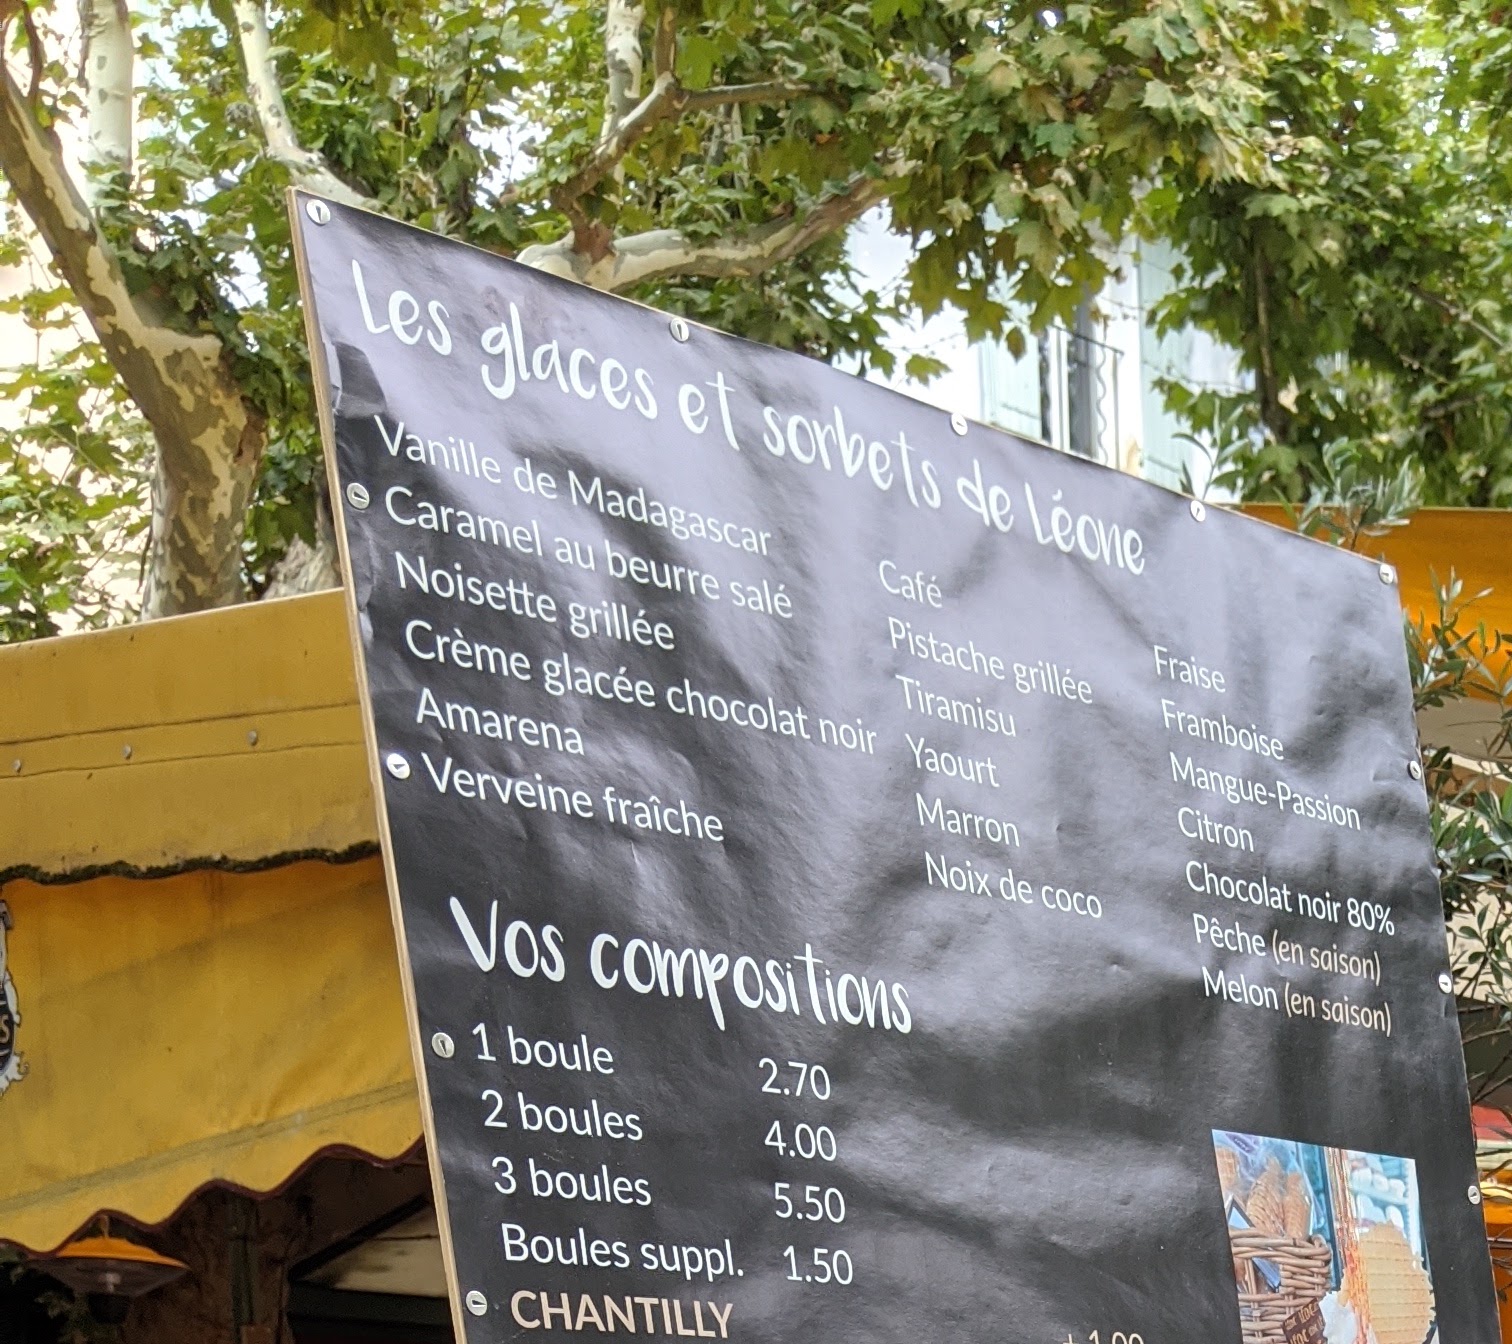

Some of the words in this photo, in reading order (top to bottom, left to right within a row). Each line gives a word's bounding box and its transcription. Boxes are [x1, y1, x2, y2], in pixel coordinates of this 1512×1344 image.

[351, 259, 453, 356] Les
[480, 301, 658, 420] glaces
[678, 371, 740, 451] et
[763, 406, 941, 509] sorbets
[956, 459, 1014, 533] de
[1024, 482, 1145, 575] Léone
[373, 413, 502, 484] Vanille
[513, 457, 558, 499] de
[567, 469, 772, 556] Madagascar
[384, 485, 543, 558] Caramel
[554, 537, 596, 572] au
[604, 538, 720, 600] beurre
[729, 579, 793, 619] salé
[879, 559, 943, 608] Café
[394, 551, 560, 624] Noisette
[568, 600, 676, 651] grillée
[404, 618, 532, 681] Crème
[541, 651, 657, 708] glacée
[665, 677, 811, 740] chocolat
[818, 718, 877, 755] noir
[888, 616, 1006, 680] Pistache
[1013, 660, 1093, 705] grillée
[1153, 644, 1226, 694] Fraise
[415, 686, 585, 756] Amarena
[894, 674, 1016, 737] Tiramisu
[1161, 698, 1285, 761] Framboise
[423, 751, 594, 818] Verveine
[601, 786, 725, 842] fraîche
[904, 733, 1000, 788] Yaourt
[1169, 751, 1361, 831] Mangue-Passion
[915, 792, 1020, 848] Marron
[1177, 806, 1255, 864] Citron
[924, 850, 993, 898] Noix
[999, 868, 1034, 905] de
[1041, 885, 1103, 919] coco
[1185, 860, 1294, 915] Chocolat
[1297, 890, 1342, 924] noir
[1346, 896, 1396, 937] 80%
[449, 895, 566, 983] Vos
[589, 932, 912, 1035] compositions
[1192, 912, 1267, 957] Pêche
[1271, 928, 1304, 966] (en
[1309, 942, 1381, 987] saison)
[1201, 965, 1280, 1011] Melon
[1284, 981, 1316, 1019] (en
[1321, 994, 1392, 1038] saison)
[471, 1022, 497, 1062] 1
[506, 1024, 615, 1075] boule
[758, 1057, 831, 1101] 2.70
[481, 1088, 509, 1129] 2
[516, 1090, 644, 1141] boules
[764, 1119, 838, 1162] 4.00
[491, 1155, 517, 1195] 3
[527, 1157, 652, 1207] boules
[774, 1181, 846, 1224] 5.50
[500, 1222, 631, 1269] Boules
[640, 1238, 744, 1283] suppl.
[782, 1244, 854, 1286] 1.50
[509, 1289, 734, 1339] CHANTILLY
